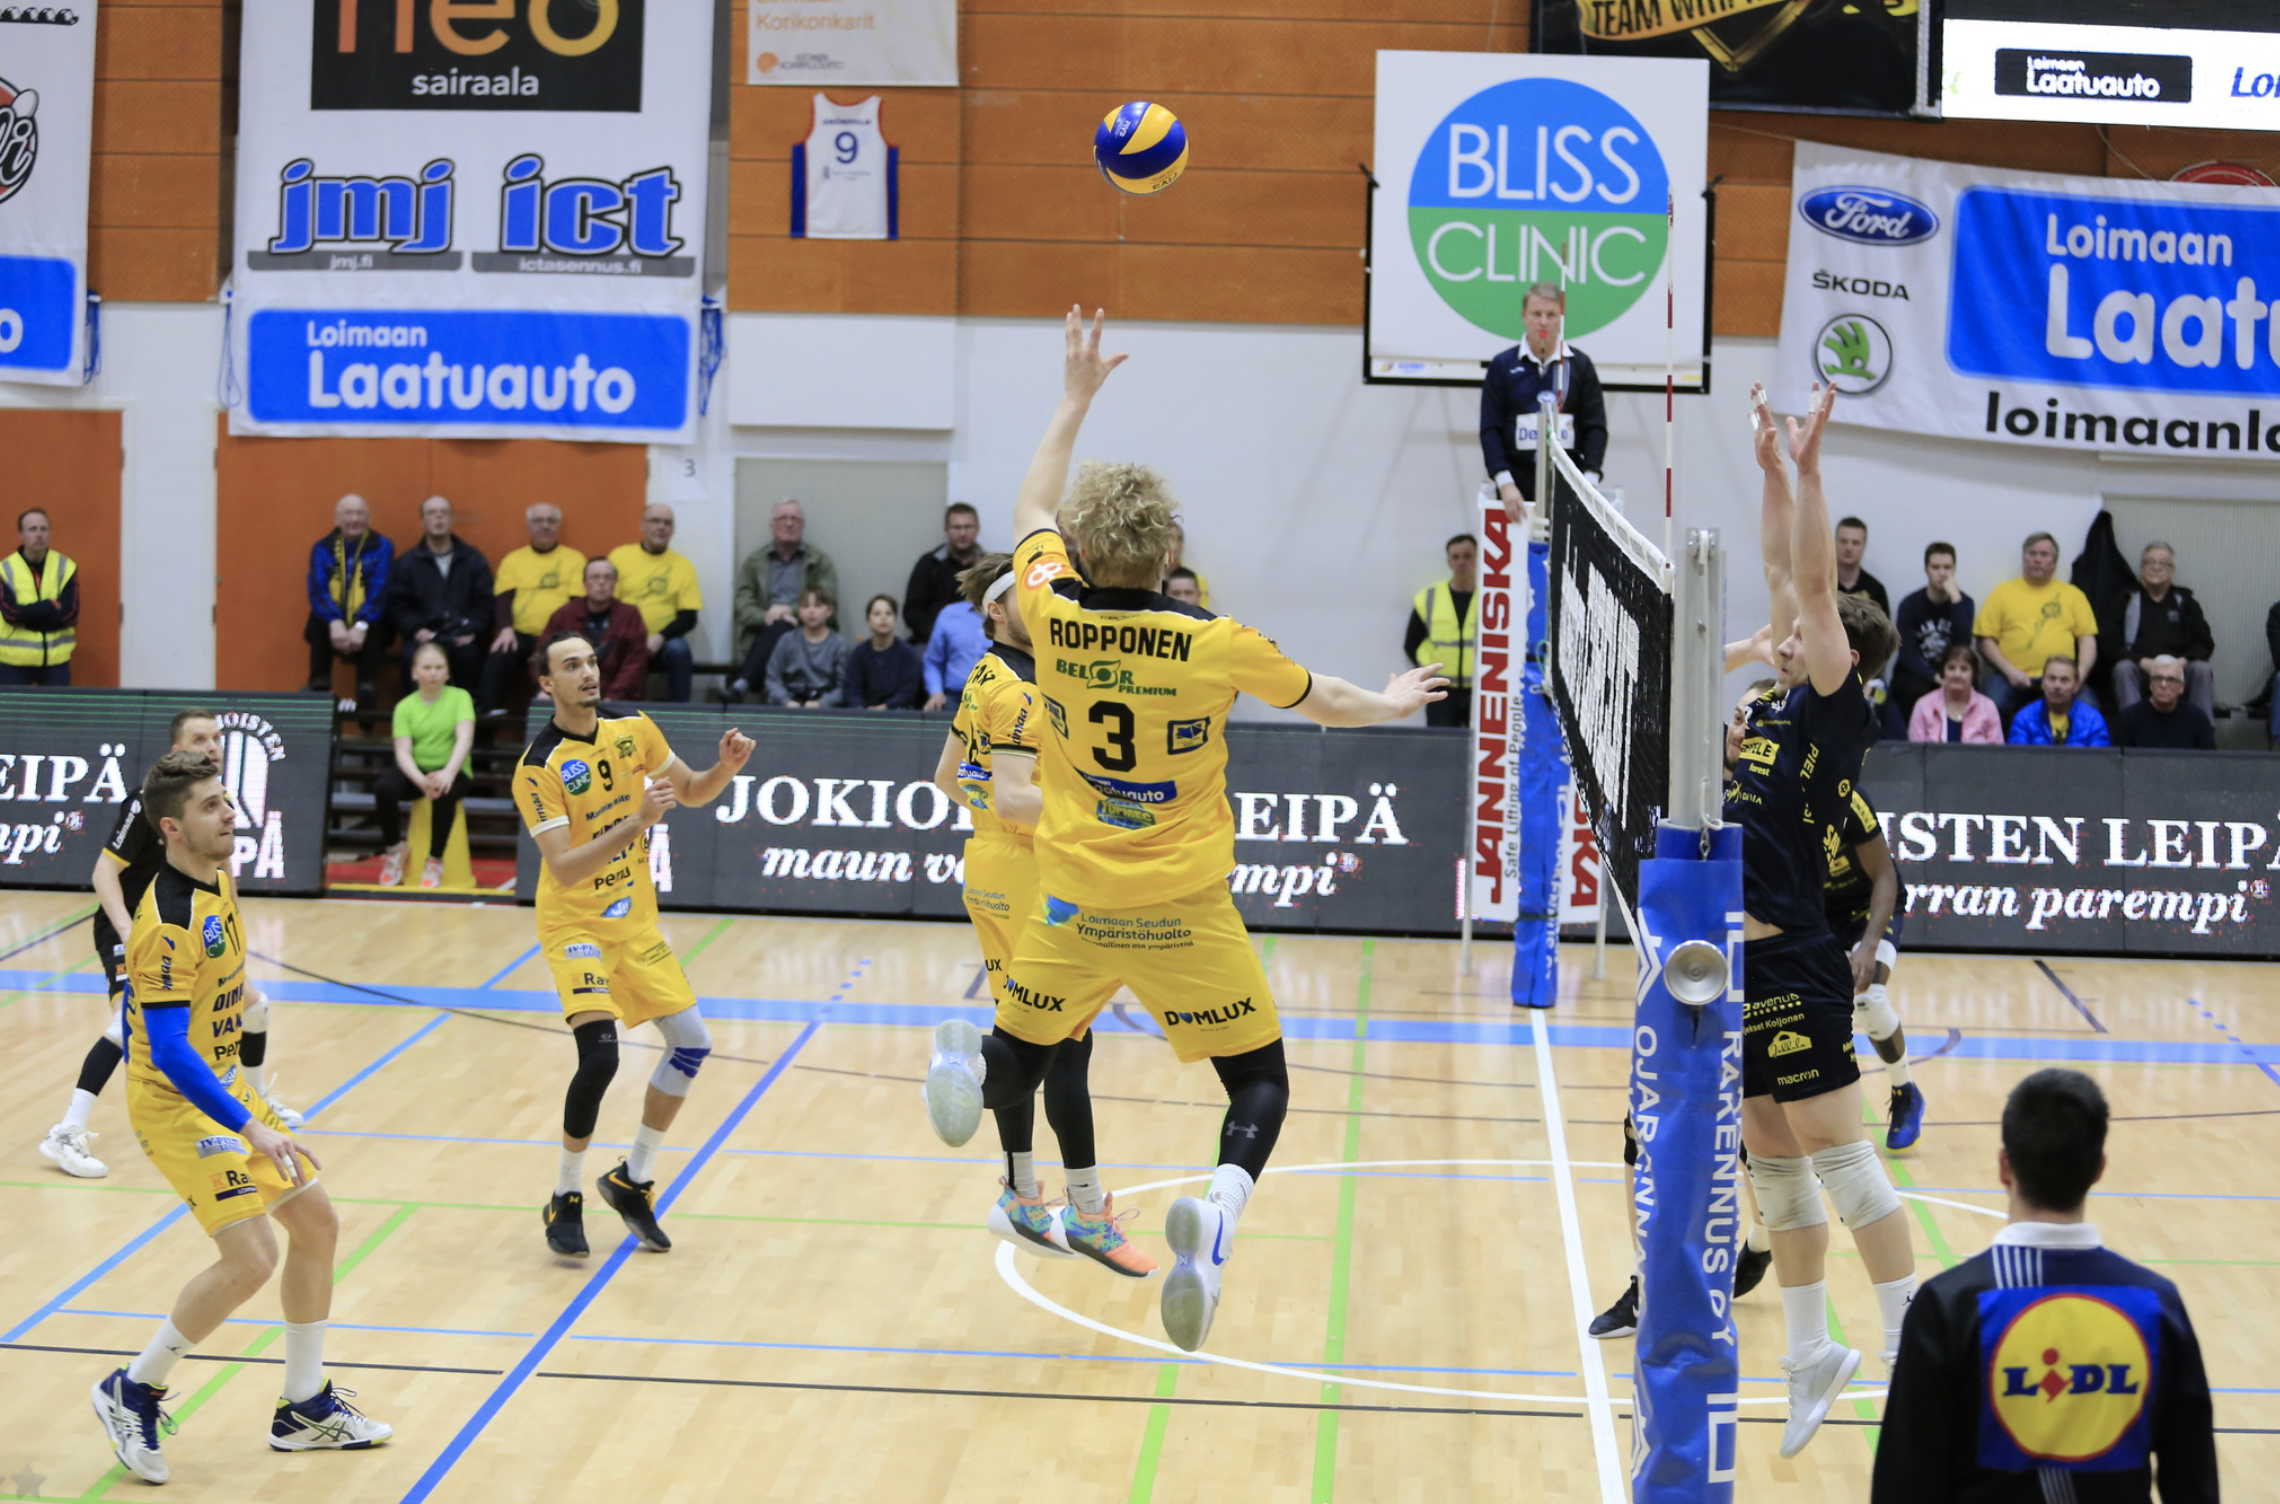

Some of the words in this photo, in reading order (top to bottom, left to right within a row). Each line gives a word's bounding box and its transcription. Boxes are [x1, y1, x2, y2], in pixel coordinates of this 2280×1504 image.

[755, 13, 876, 31] Korikonkarit
[411, 66, 539, 97] sairaala
[2026, 69, 2161, 98] Laatuauto
[835, 131, 859, 164] 9
[1449, 123, 1641, 205] BLISS
[269, 157, 457, 255] jmj
[500, 153, 685, 258] ict
[1825, 190, 1913, 240] Ford
[1427, 221, 1648, 287] CLINIC
[2045, 213, 2234, 267] Loimaan
[330, 255, 374, 272] jmj.fi
[518, 256, 643, 275] ictasennus.fi
[1812, 268, 1910, 302] ŠKODA
[307, 319, 428, 348] Loimaan
[2045, 263, 2280, 371] Laat
[308, 349, 637, 415] Laatuauto
[684, 458, 697, 479] 3
[1050, 617, 1193, 662] ROPPONEN
[1118, 683, 1177, 697] PREMIUM
[1475, 508, 1512, 904] JANNENISKA
[1088, 700, 1137, 773] 3
[1509, 696, 1524, 756] People
[561, 761, 586, 784] BLISS
[597, 759, 614, 792] 9
[1509, 761, 1521, 778] of
[1234, 782, 1410, 845] EIPÄ
[1506, 780, 1520, 835] Lifting
[761, 846, 914, 883] maun
[1505, 841, 1518, 879] Safe
[1903, 883, 2021, 917] rran
[1076, 923, 1192, 941] Ympäristöhuolto
[1081, 912, 1134, 927] Loimaan
[1136, 917, 1182, 928] Seudun
[1765, 1012, 1806, 1028] Koljonen
[1702, 1030, 1743, 1274] RAKENNUS
[2002, 1347, 2141, 1404] LIDL
